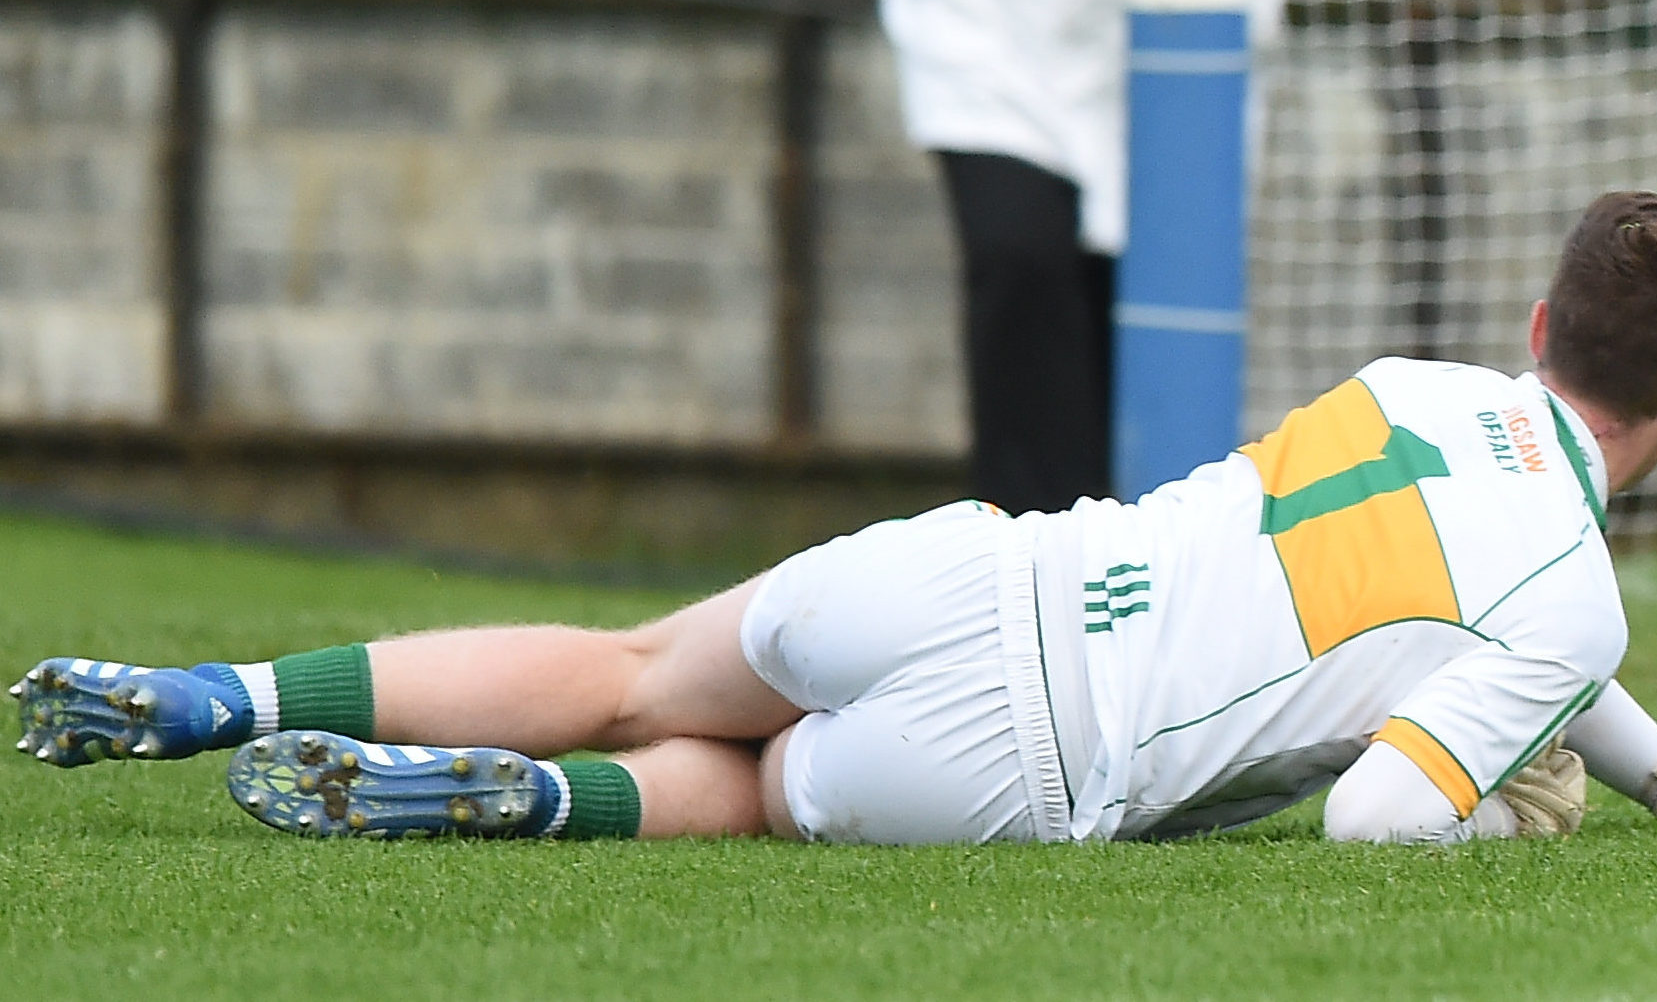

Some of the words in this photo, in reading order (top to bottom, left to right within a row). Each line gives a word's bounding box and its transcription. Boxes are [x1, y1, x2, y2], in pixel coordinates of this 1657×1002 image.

[1476, 411, 1523, 474] OFFALY
[1501, 404, 1548, 473] JIGSAW
[1259, 424, 1451, 535] 1
